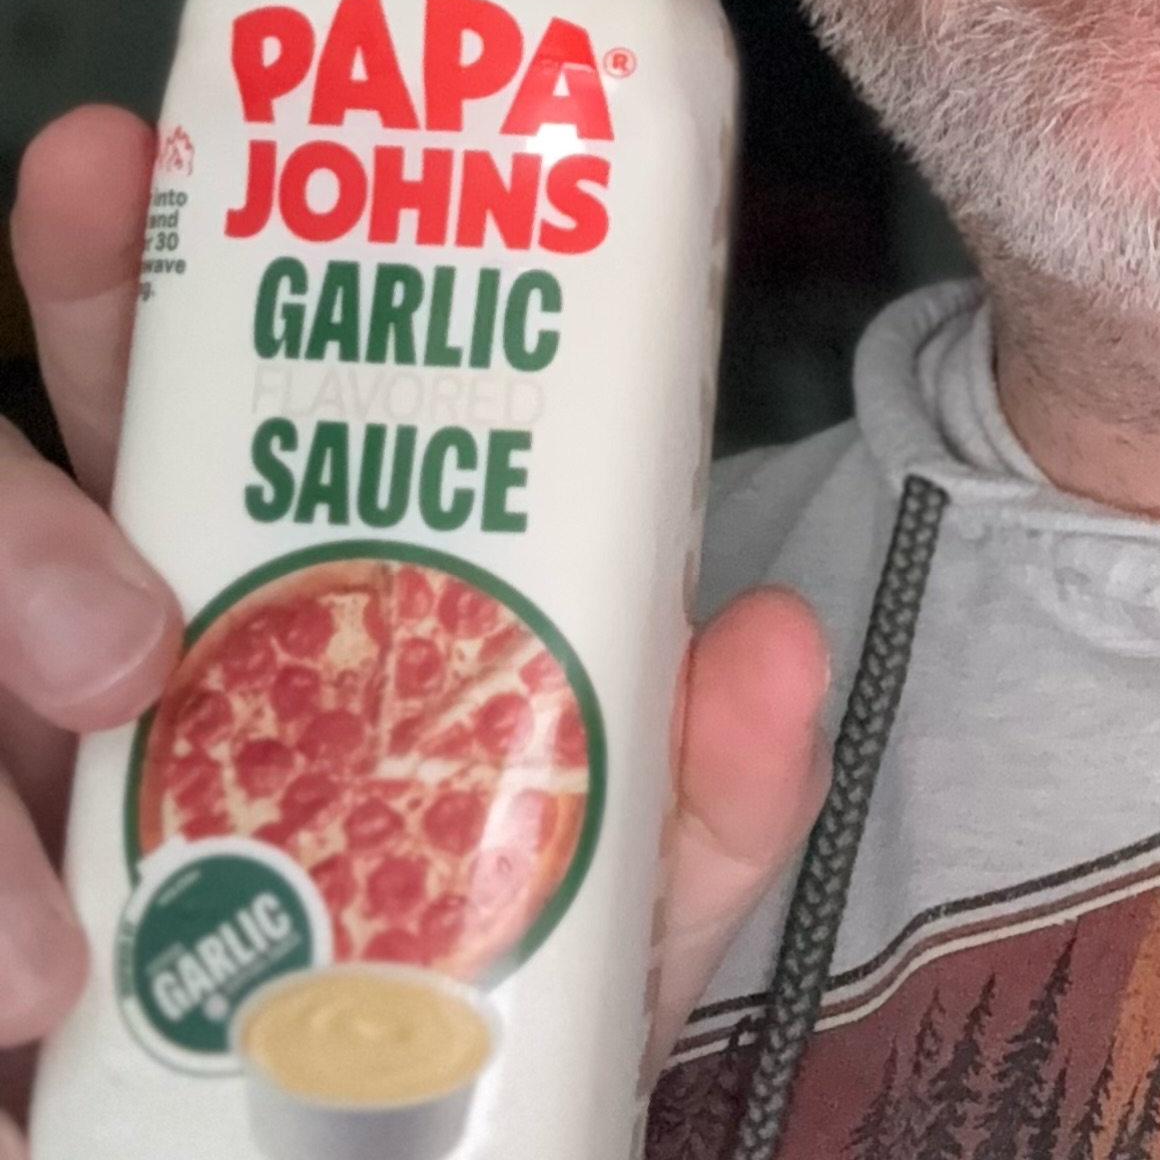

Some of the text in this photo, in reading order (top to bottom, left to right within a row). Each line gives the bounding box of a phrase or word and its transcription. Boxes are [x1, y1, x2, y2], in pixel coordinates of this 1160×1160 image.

[155, 231, 180, 251] 30
[224, 139, 611, 254] JOHNS
[253, 256, 563, 372] GARLIC
[251, 363, 546, 427] FLAVORED
[244, 417, 533, 533] SAUCE
[152, 891, 292, 1021] GARLIC
